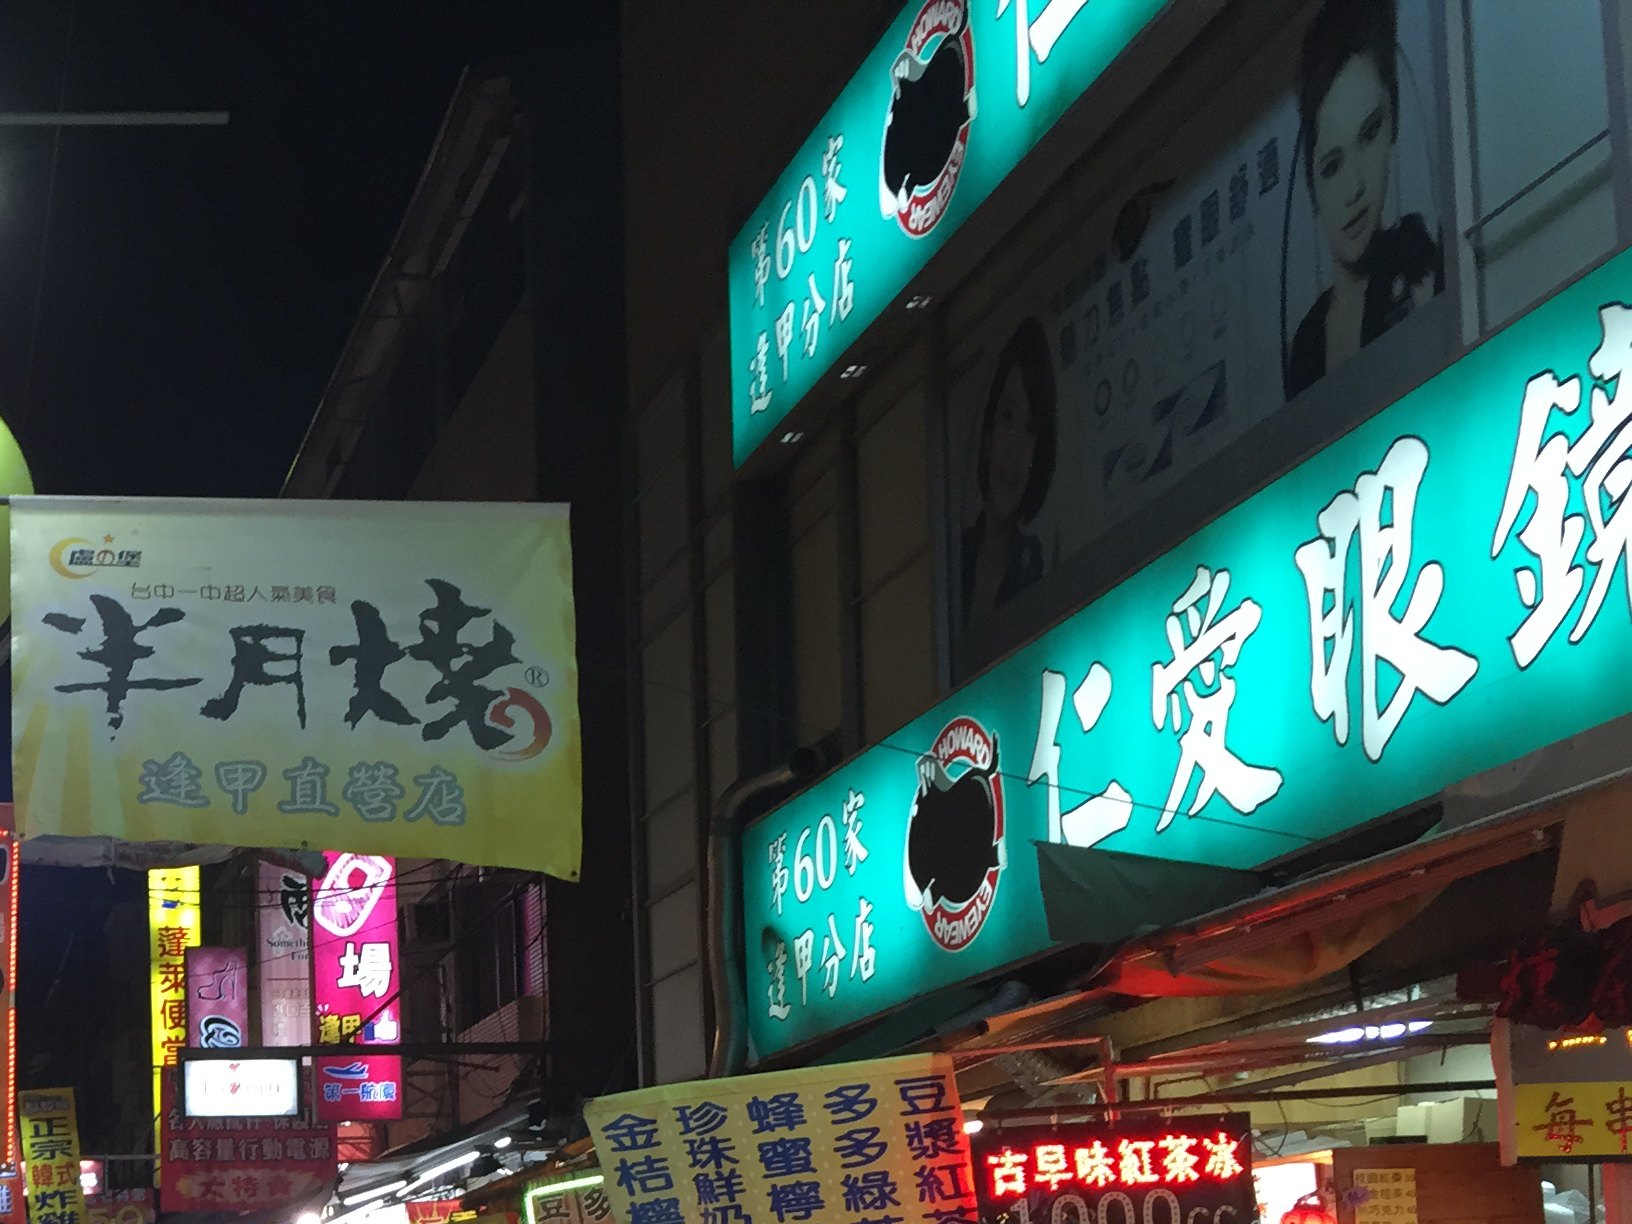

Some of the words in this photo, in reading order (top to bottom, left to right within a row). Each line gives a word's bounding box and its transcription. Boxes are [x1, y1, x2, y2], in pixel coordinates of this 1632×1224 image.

[751, 133, 848, 308] 第60家
[749, 237, 855, 416] 逢甲分店
[131, 582, 337, 605] 台中一中超人氣美食
[41, 578, 521, 752] 半月燒
[938, 725, 991, 770] HOWARD
[137, 751, 468, 827] 逢甲直營店
[768, 787, 870, 916] 第60家
[337, 941, 392, 998] 場
[767, 896, 876, 1022] 逢甲分店
[169, 1137, 329, 1162] 高容量行動電源
[987, 1131, 1245, 1197] 古早味紅茶冰
